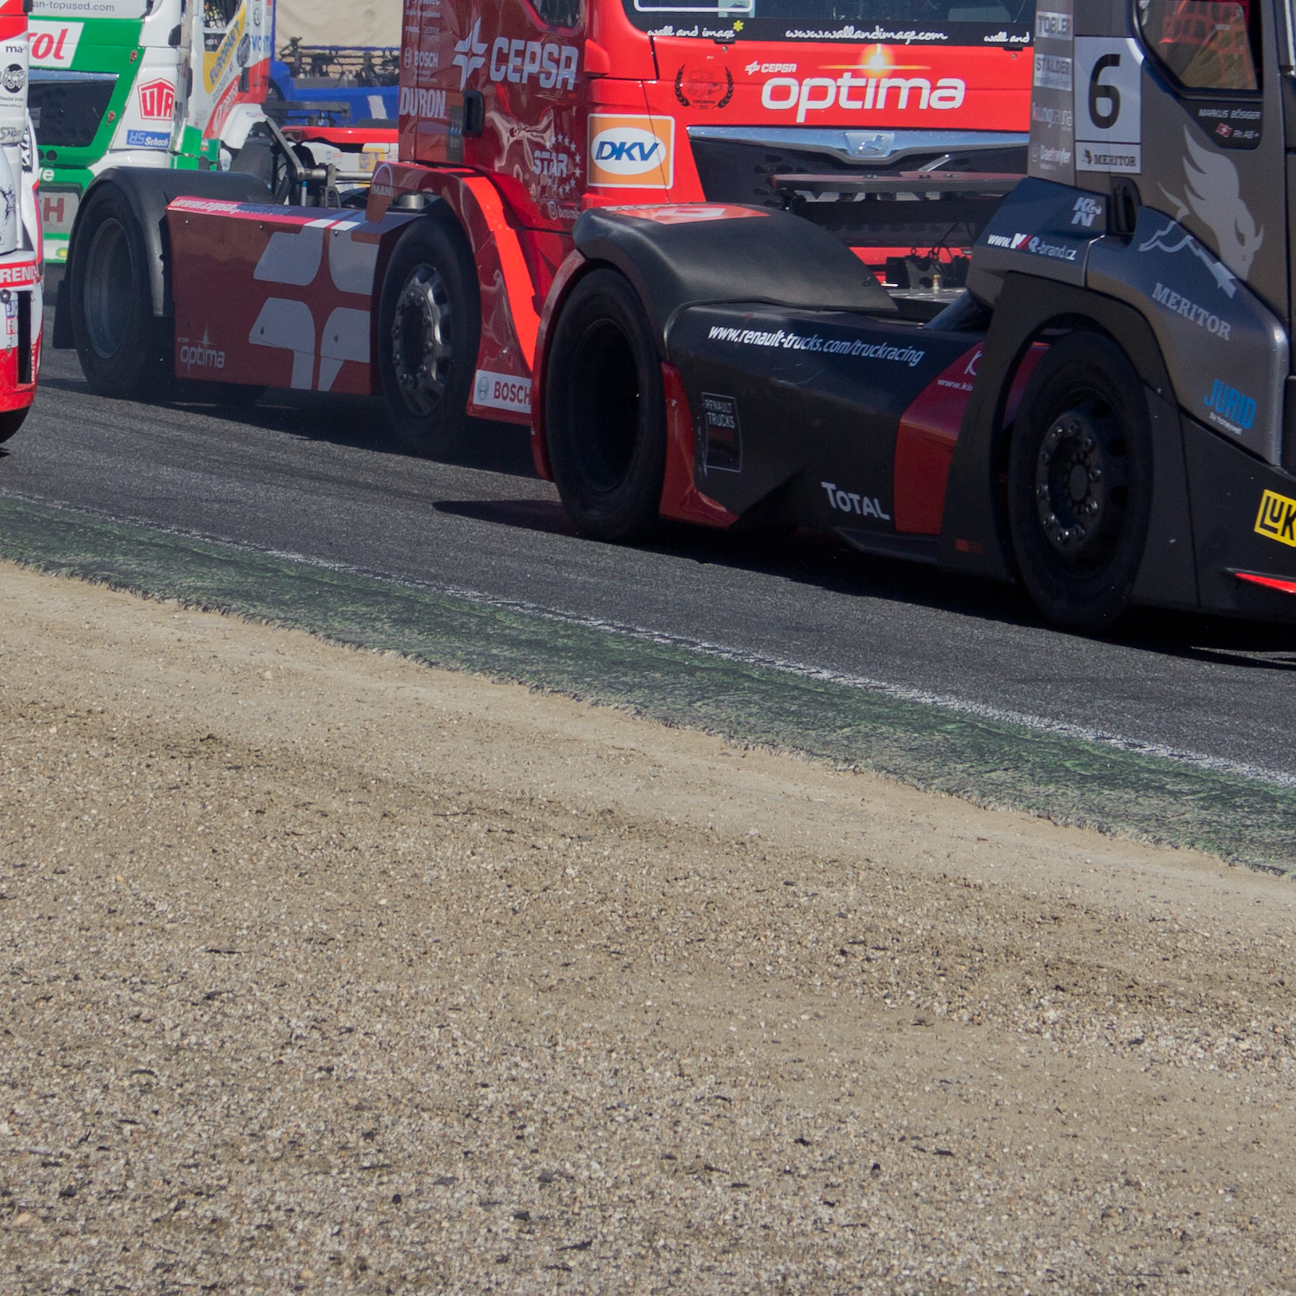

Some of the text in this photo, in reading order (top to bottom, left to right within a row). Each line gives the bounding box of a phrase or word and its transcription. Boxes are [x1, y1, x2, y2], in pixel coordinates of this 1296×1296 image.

[32, 0, 115, 13] an-topused.com
[414, 50, 439, 67] BOSCH
[489, 36, 579, 91] CEPSA
[761, 62, 797, 74] CEPSA
[399, 86, 446, 119] DURON
[761, 71, 966, 123] optima
[1088, 53, 1122, 129] 6
[533, 150, 569, 178] STAR
[595, 140, 659, 162] DKV
[1093, 154, 1137, 167] MERITOR
[1151, 281, 1232, 342] MERITOR
[180, 344, 226, 372] optima
[707, 324, 926, 368] www.renault-trucks.com/truckracing
[493, 380, 532, 405] BOSCH
[1203, 378, 1258, 431] JURID
[707, 412, 736, 430] TRUCKS
[821, 481, 892, 521] TOTAL
